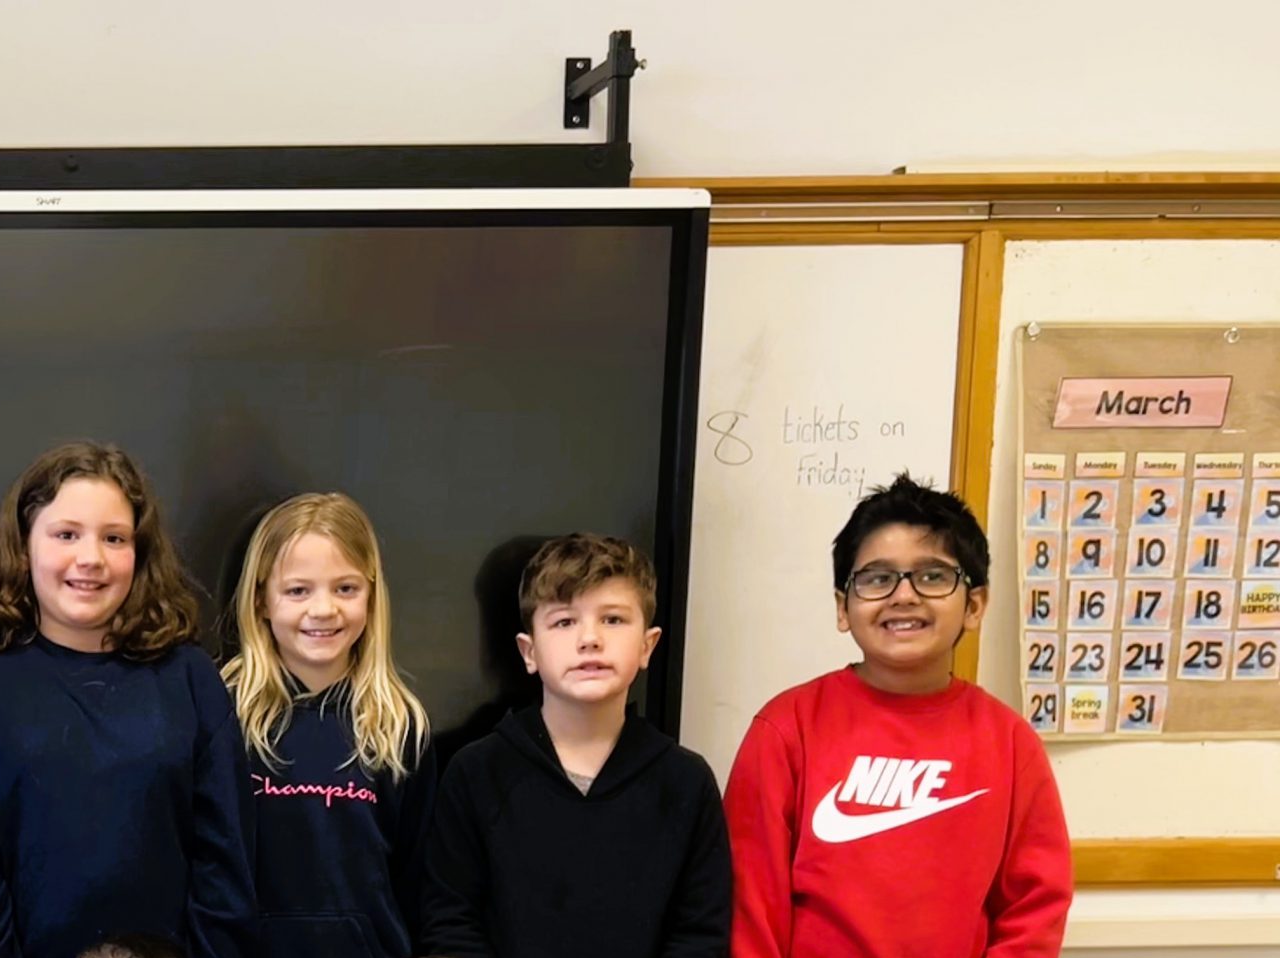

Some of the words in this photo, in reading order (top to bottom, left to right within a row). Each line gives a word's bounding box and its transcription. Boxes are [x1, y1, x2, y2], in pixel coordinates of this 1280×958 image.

[1095, 390, 1192, 416] March
[706, 411, 753, 466] 8
[783, 404, 860, 444] tickets
[879, 419, 905, 437] on
[797, 452, 866, 500] Friday
[1083, 461, 1118, 471] Monday
[1039, 491, 1047, 520] 1
[1082, 491, 1104, 520] 2
[1147, 489, 1167, 518] 3
[1206, 489, 1226, 519] 4
[1265, 490, 1280, 519] 5
[1035, 541, 1049, 569] 8
[1081, 539, 1102, 567] 9
[1136, 538, 1166, 567] 10
[1203, 539, 1219, 567] 11
[1255, 539, 1280, 568] 12
[1031, 590, 1050, 619] 15
[1078, 590, 1106, 619] 16
[1134, 590, 1162, 619] 17
[1194, 590, 1222, 619] 18
[1028, 644, 1055, 671] 22
[1070, 644, 1104, 672] 23
[1124, 643, 1164, 671] 24
[1183, 641, 1223, 669] 25
[1237, 641, 1277, 669] 26
[1030, 694, 1056, 722] 29
[1128, 695, 1155, 723] 31
[838, 755, 952, 808] NIKE
